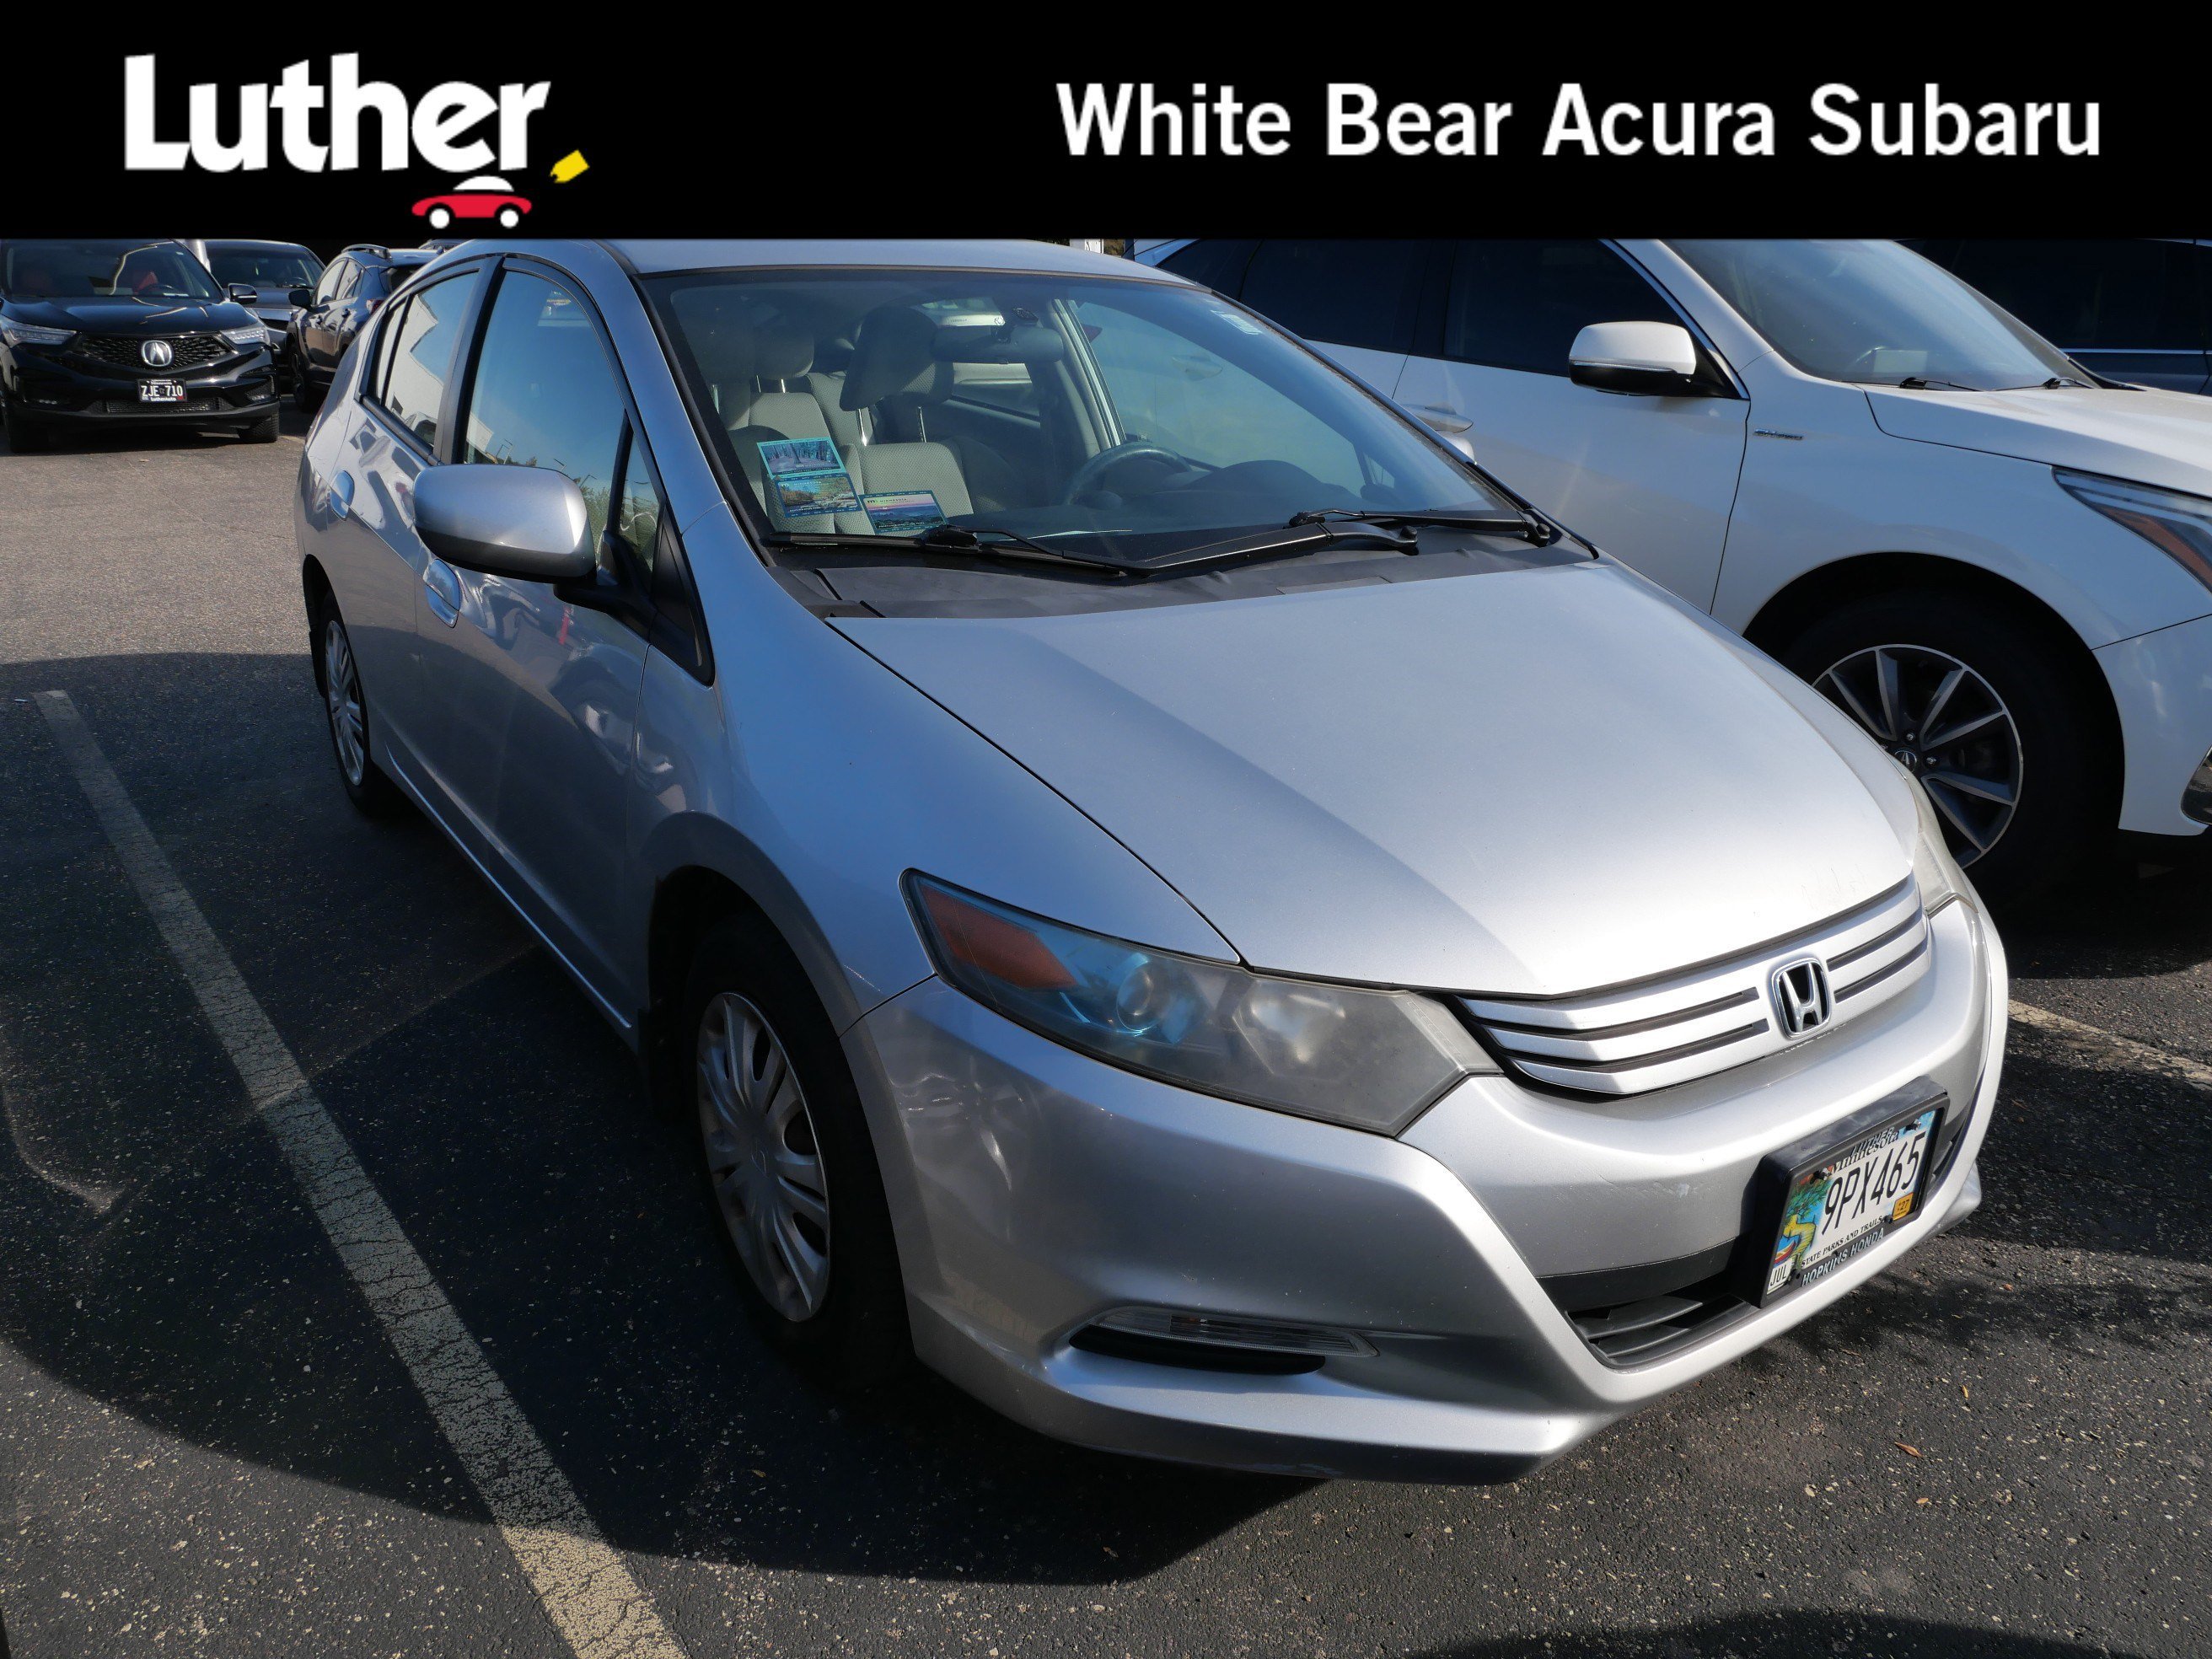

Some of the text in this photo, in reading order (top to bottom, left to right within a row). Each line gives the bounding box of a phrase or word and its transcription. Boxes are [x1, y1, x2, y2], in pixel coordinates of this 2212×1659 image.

[141, 384, 184, 397] ZJE 710
[1821, 1130, 1927, 1236] 9PX465
[1801, 1215, 1884, 1267] STATE PARKS AND TRAILS
[1801, 1227, 1885, 1287] HOPKINS HONDA
[1769, 1264, 1788, 1286] JUL
